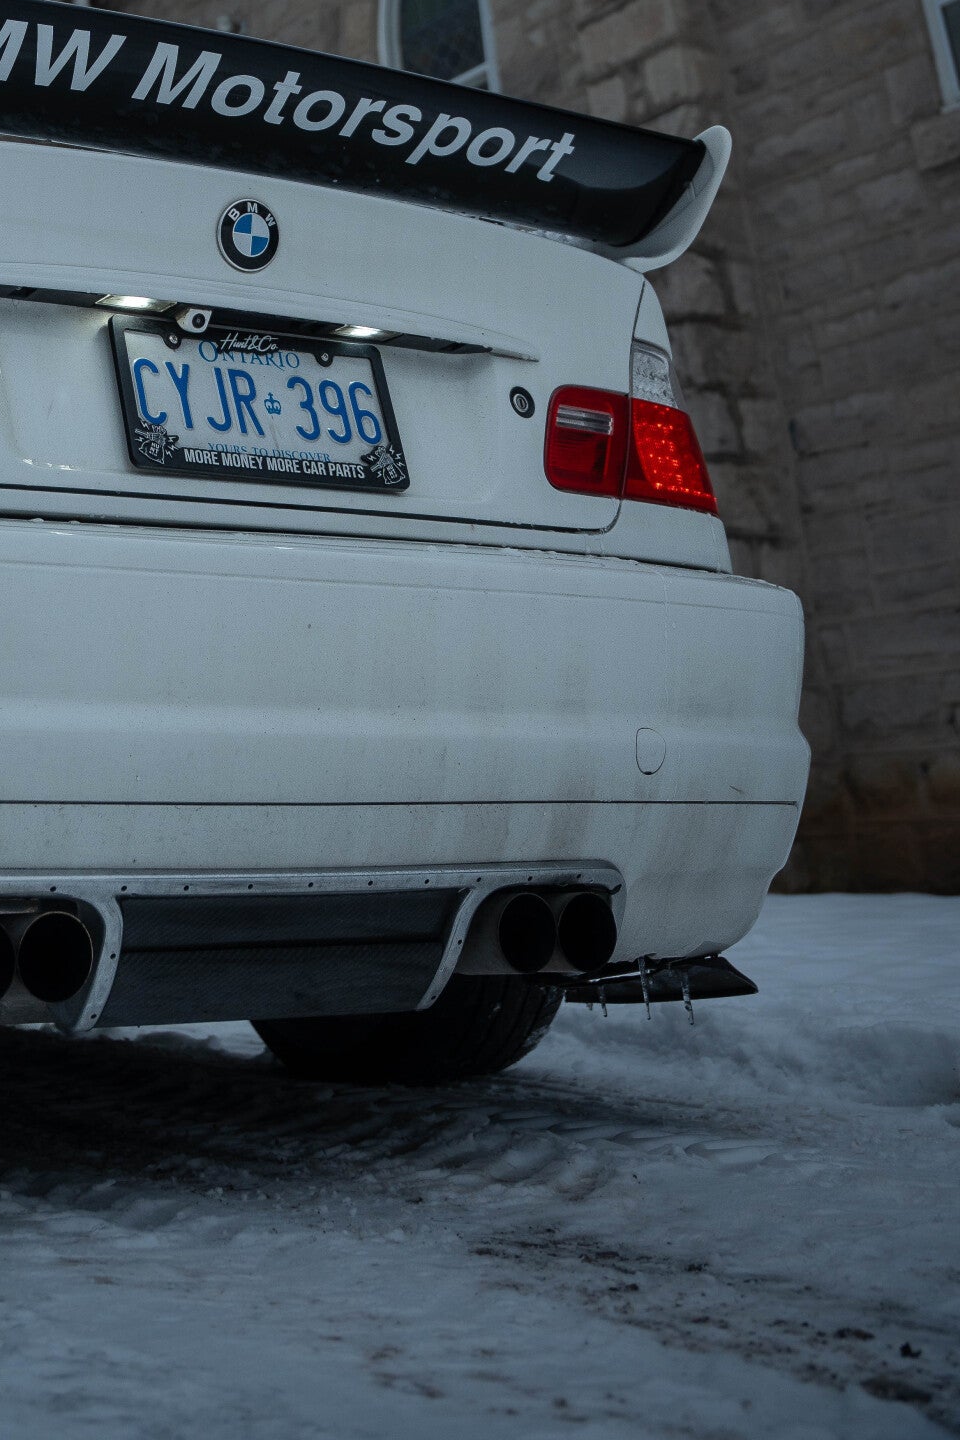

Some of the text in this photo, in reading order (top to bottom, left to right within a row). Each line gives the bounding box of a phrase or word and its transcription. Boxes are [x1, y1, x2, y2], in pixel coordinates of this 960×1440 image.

[132, 41, 576, 182] Motorsport
[228, 202, 276, 227] BMW
[133, 358, 382, 444] CYJR 396
[183, 448, 220, 466] MORE
[221, 452, 263, 470] MONEY
[267, 457, 301, 474] MORE
[302, 460, 327, 477] CAR
[329, 463, 366, 479] PARTS
